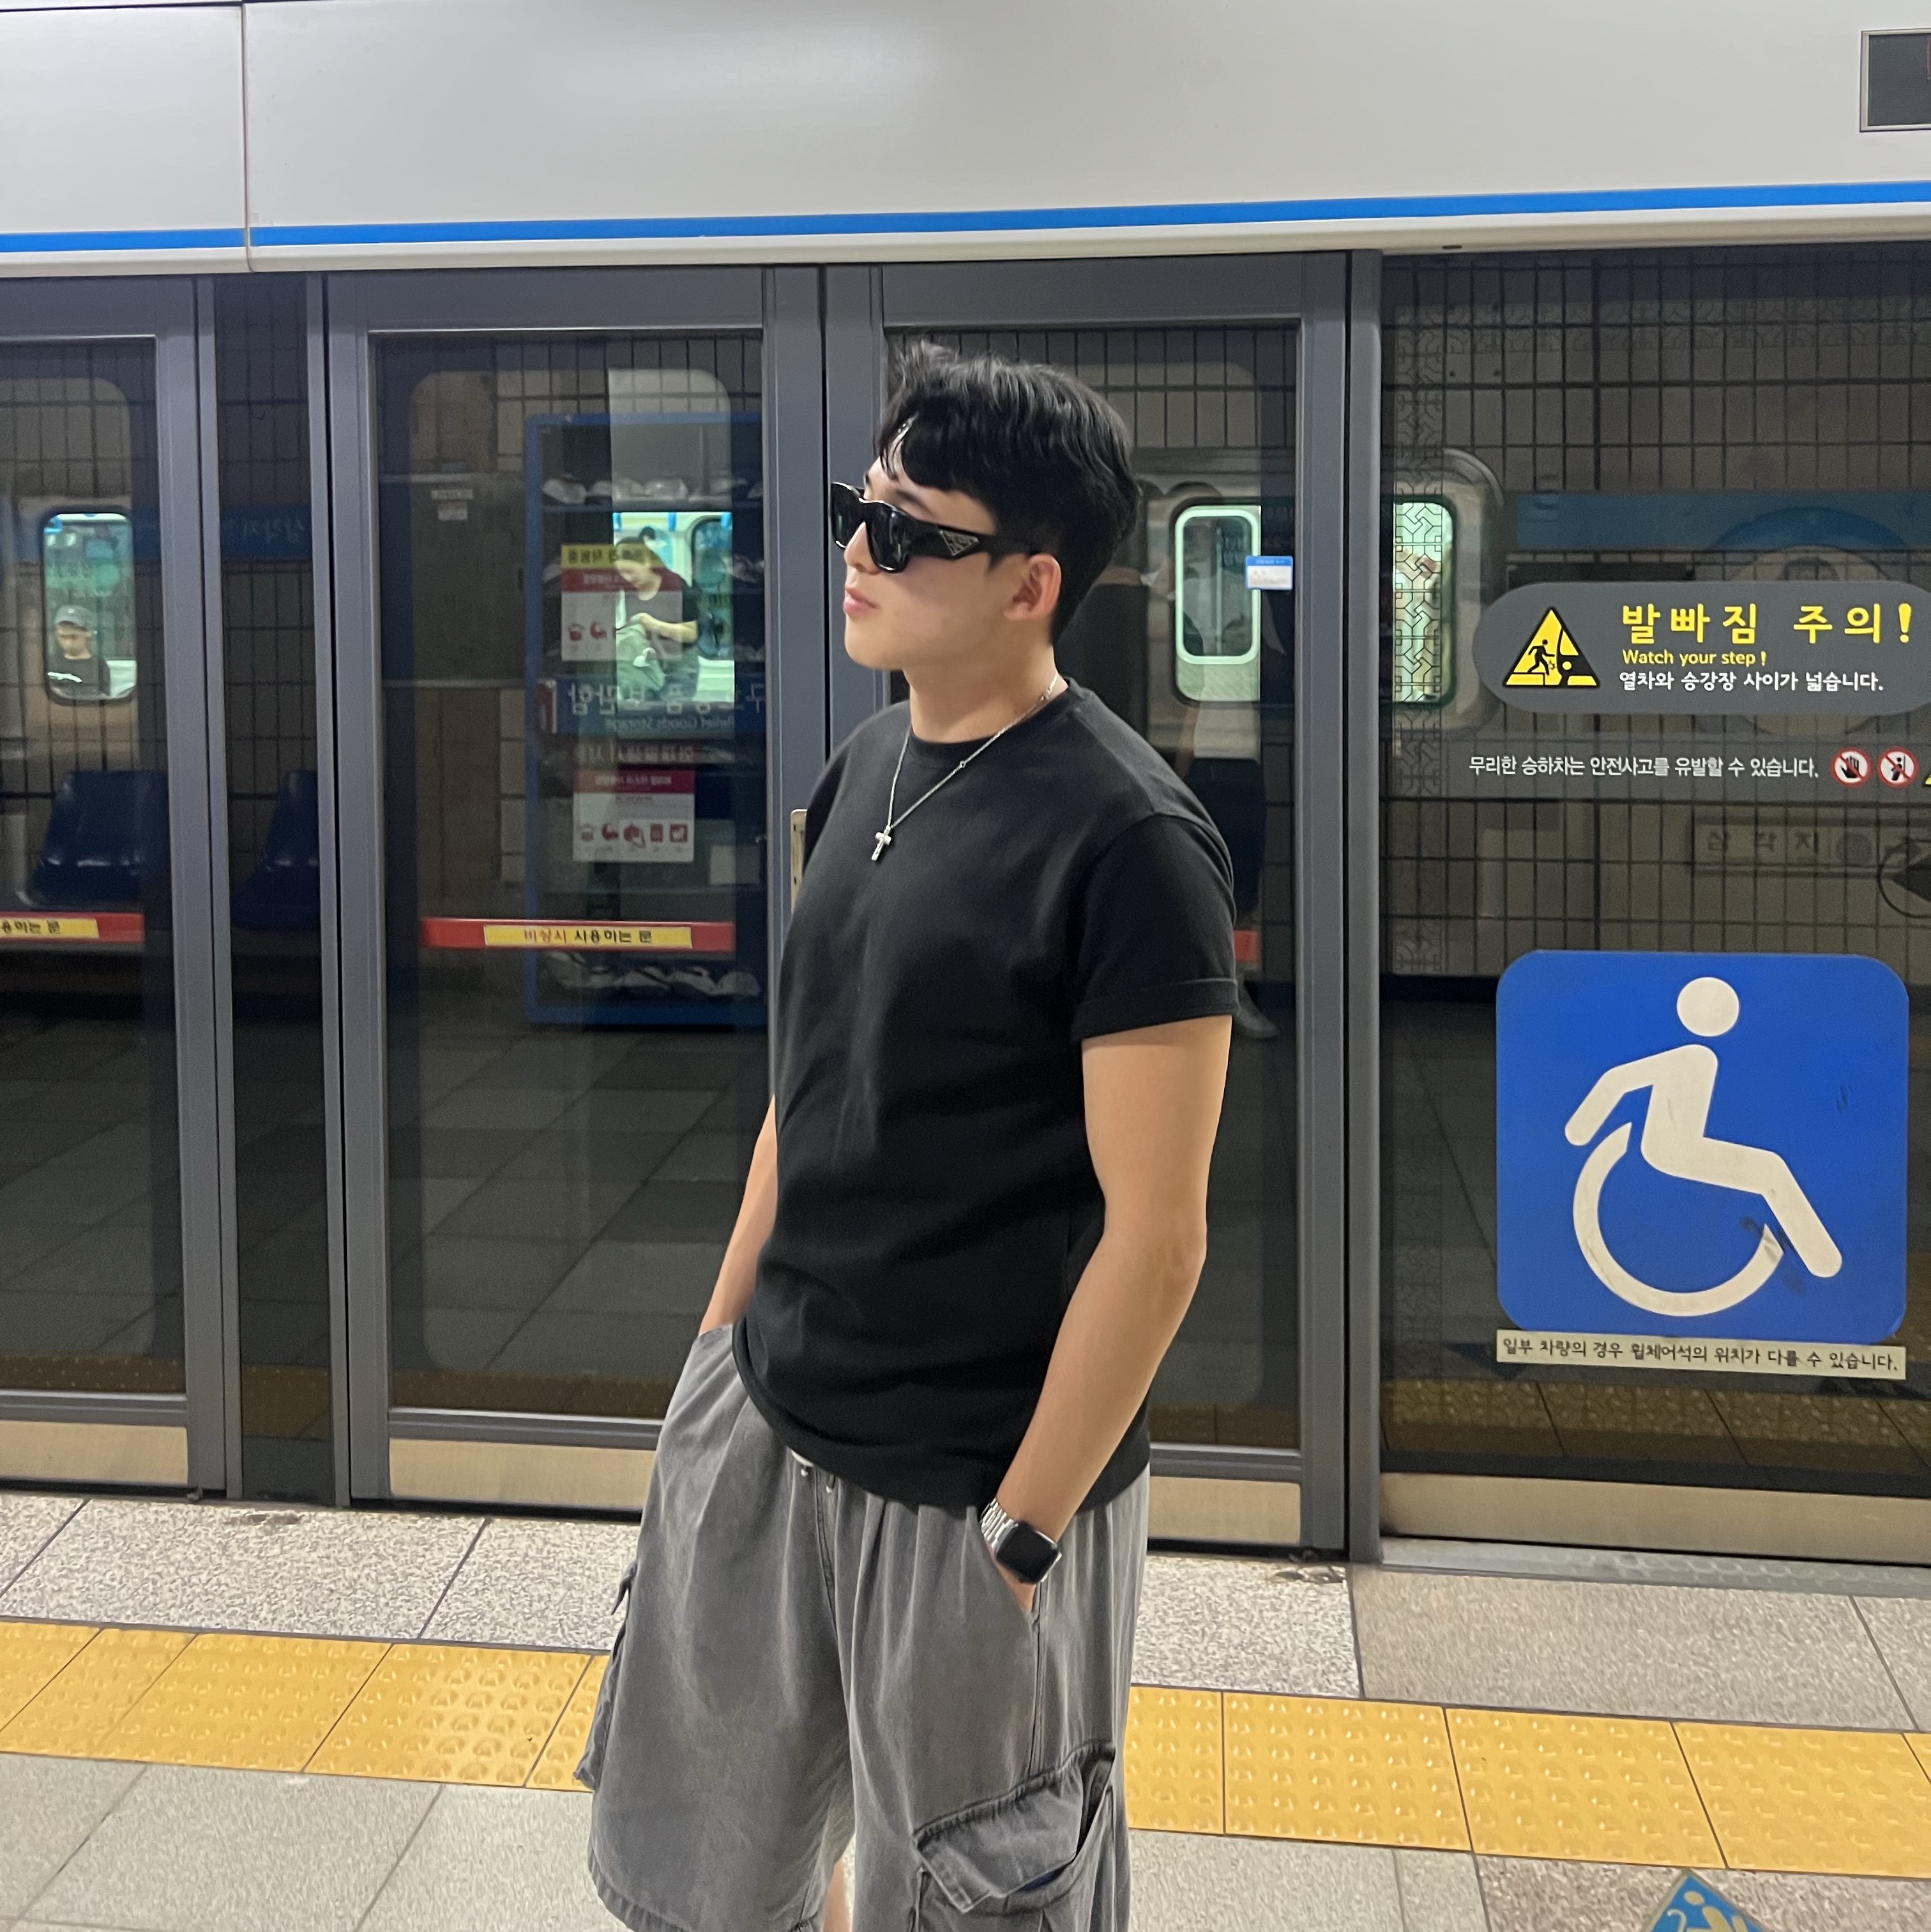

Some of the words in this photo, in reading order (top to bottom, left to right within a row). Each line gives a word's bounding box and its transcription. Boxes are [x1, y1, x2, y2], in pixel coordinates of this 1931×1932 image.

[1622, 603, 1757, 645] 발빠짐
[1793, 603, 1912, 645] 주의!
[1622, 649, 1674, 666] Watch
[1679, 652, 1717, 668] your
[1619, 671, 1675, 692] 열차와
[1681, 671, 1738, 692] 승강장
[1743, 671, 1799, 692] 사이가
[1805, 671, 1884, 693] 넓습니다.
[1468, 755, 1517, 777] 무리한
[1521, 755, 1586, 777] 승하차는
[1589, 756, 1670, 779] 안전사고를
[1674, 756, 1724, 779] 유발할
[1727, 757, 1746, 779] 수
[1750, 757, 1820, 779] 있습니다.
[524, 927, 567, 943] 비상시
[1503, 1337, 1533, 1355] 일부
[1539, 1339, 1586, 1358] 차량의
[1593, 1341, 1623, 1360] 경우
[1631, 1342, 1708, 1363] 휠체어석의
[1714, 1346, 1761, 1365] 위치가
[1768, 1348, 1799, 1367] 다를
[1806, 1350, 1823, 1368] 수
[1829, 1351, 1899, 1372] 있습니다.
